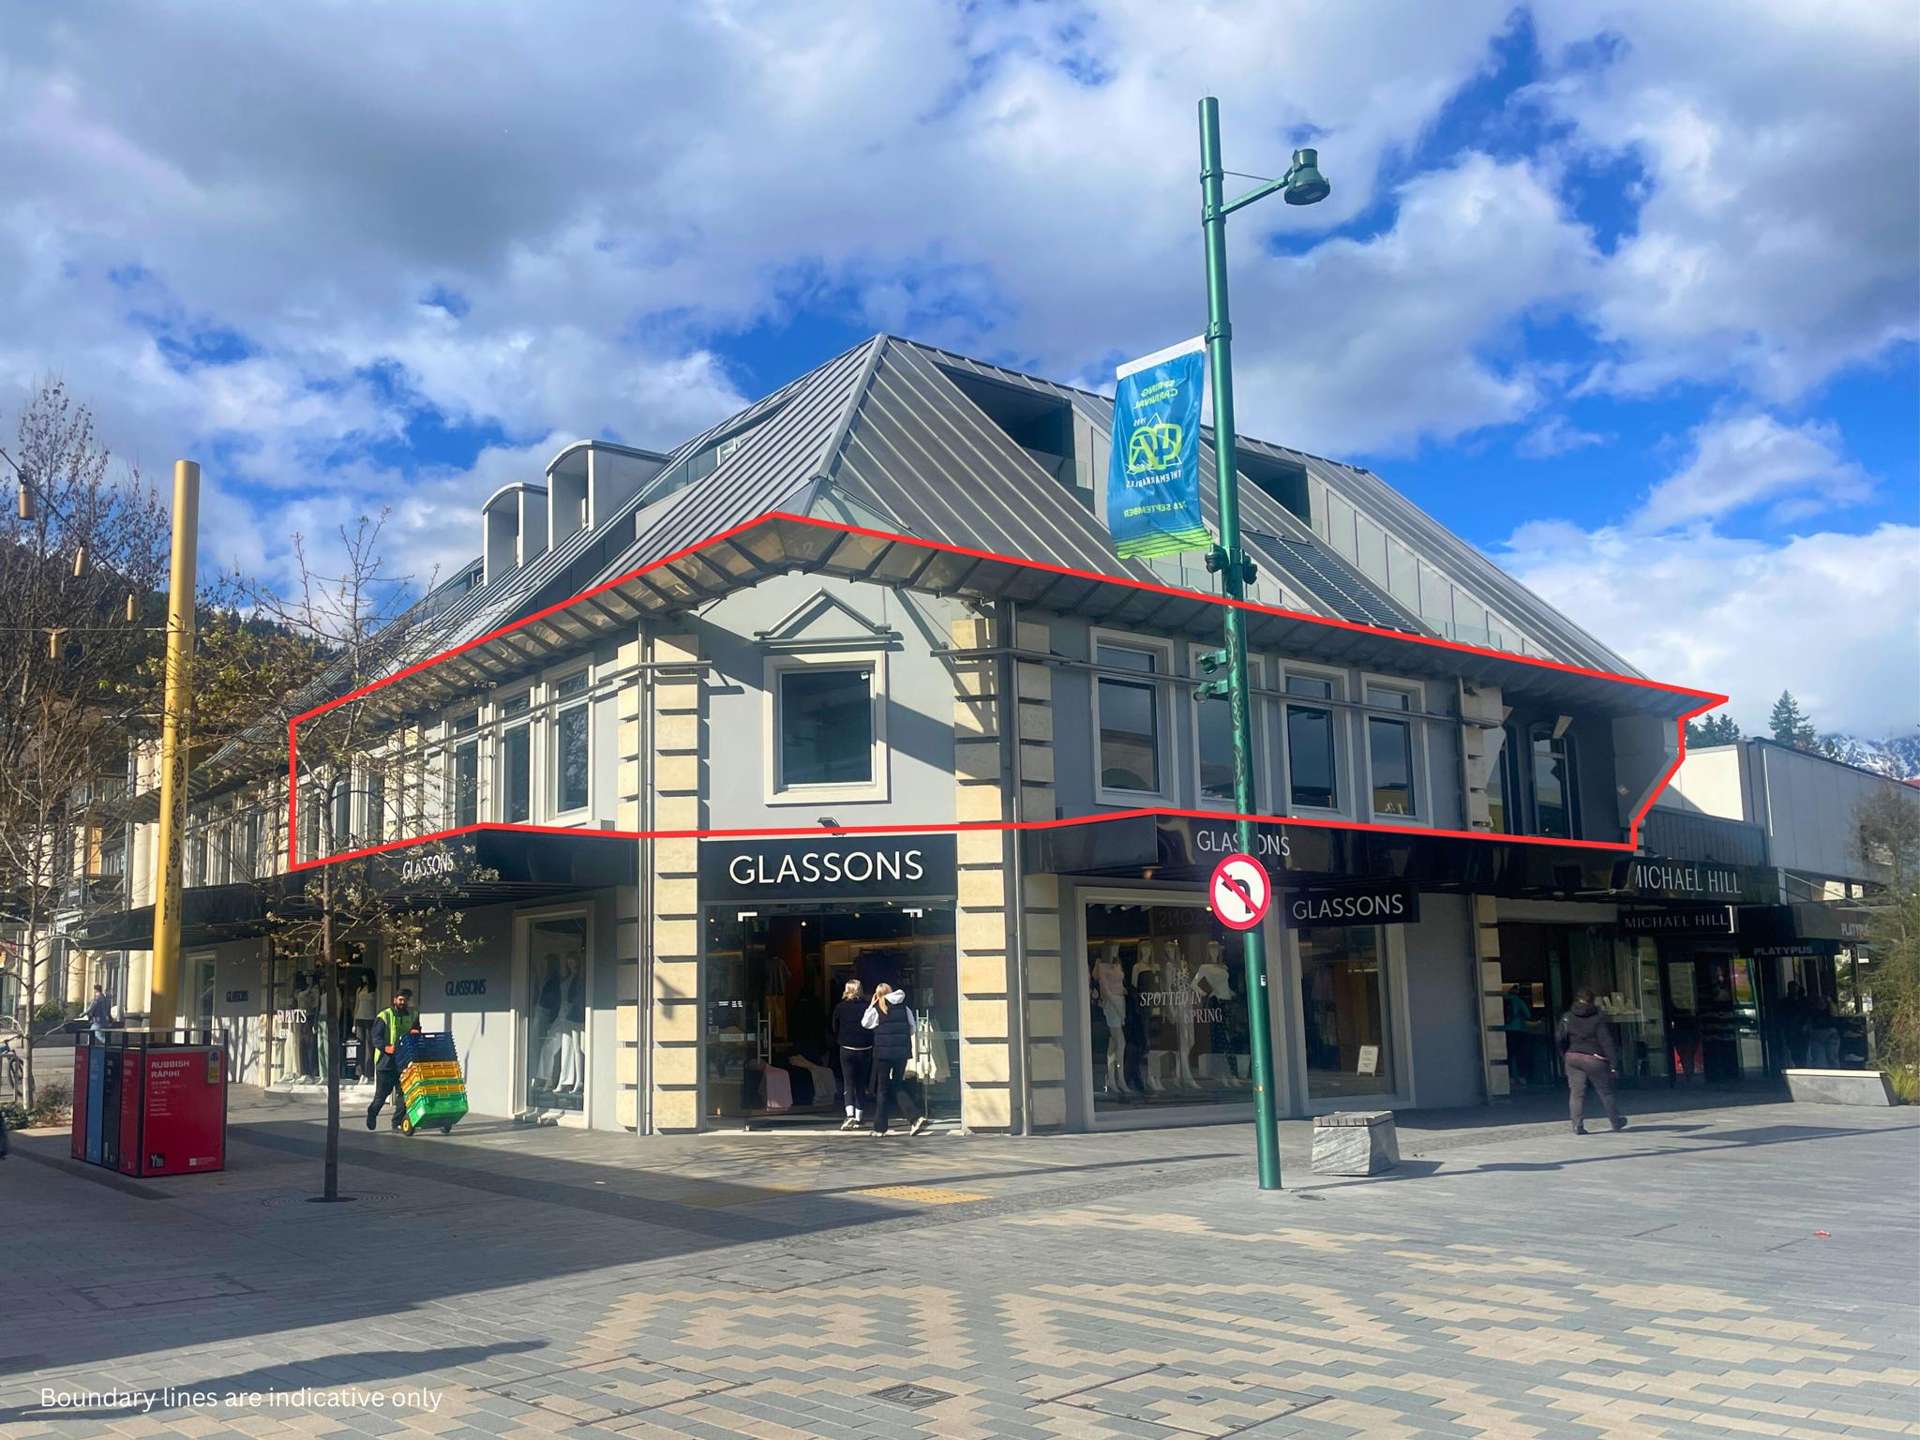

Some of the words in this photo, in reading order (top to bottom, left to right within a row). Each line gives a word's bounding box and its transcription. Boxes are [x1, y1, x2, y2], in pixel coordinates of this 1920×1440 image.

[1196, 830, 1290, 857] GLASONS
[729, 849, 924, 885] GLASSONS
[1708, 870, 1742, 894] HILL
[1292, 894, 1404, 920] GLASSONS
[1624, 915, 1691, 929] MICHAEL
[1695, 913, 1728, 927] HILL
[1753, 945, 1813, 956] PLATYPUS
[1139, 991, 1188, 1007] SPOTTED
[1184, 1008, 1223, 1025] SPRING
[151, 1060, 190, 1070] RUBBISH
